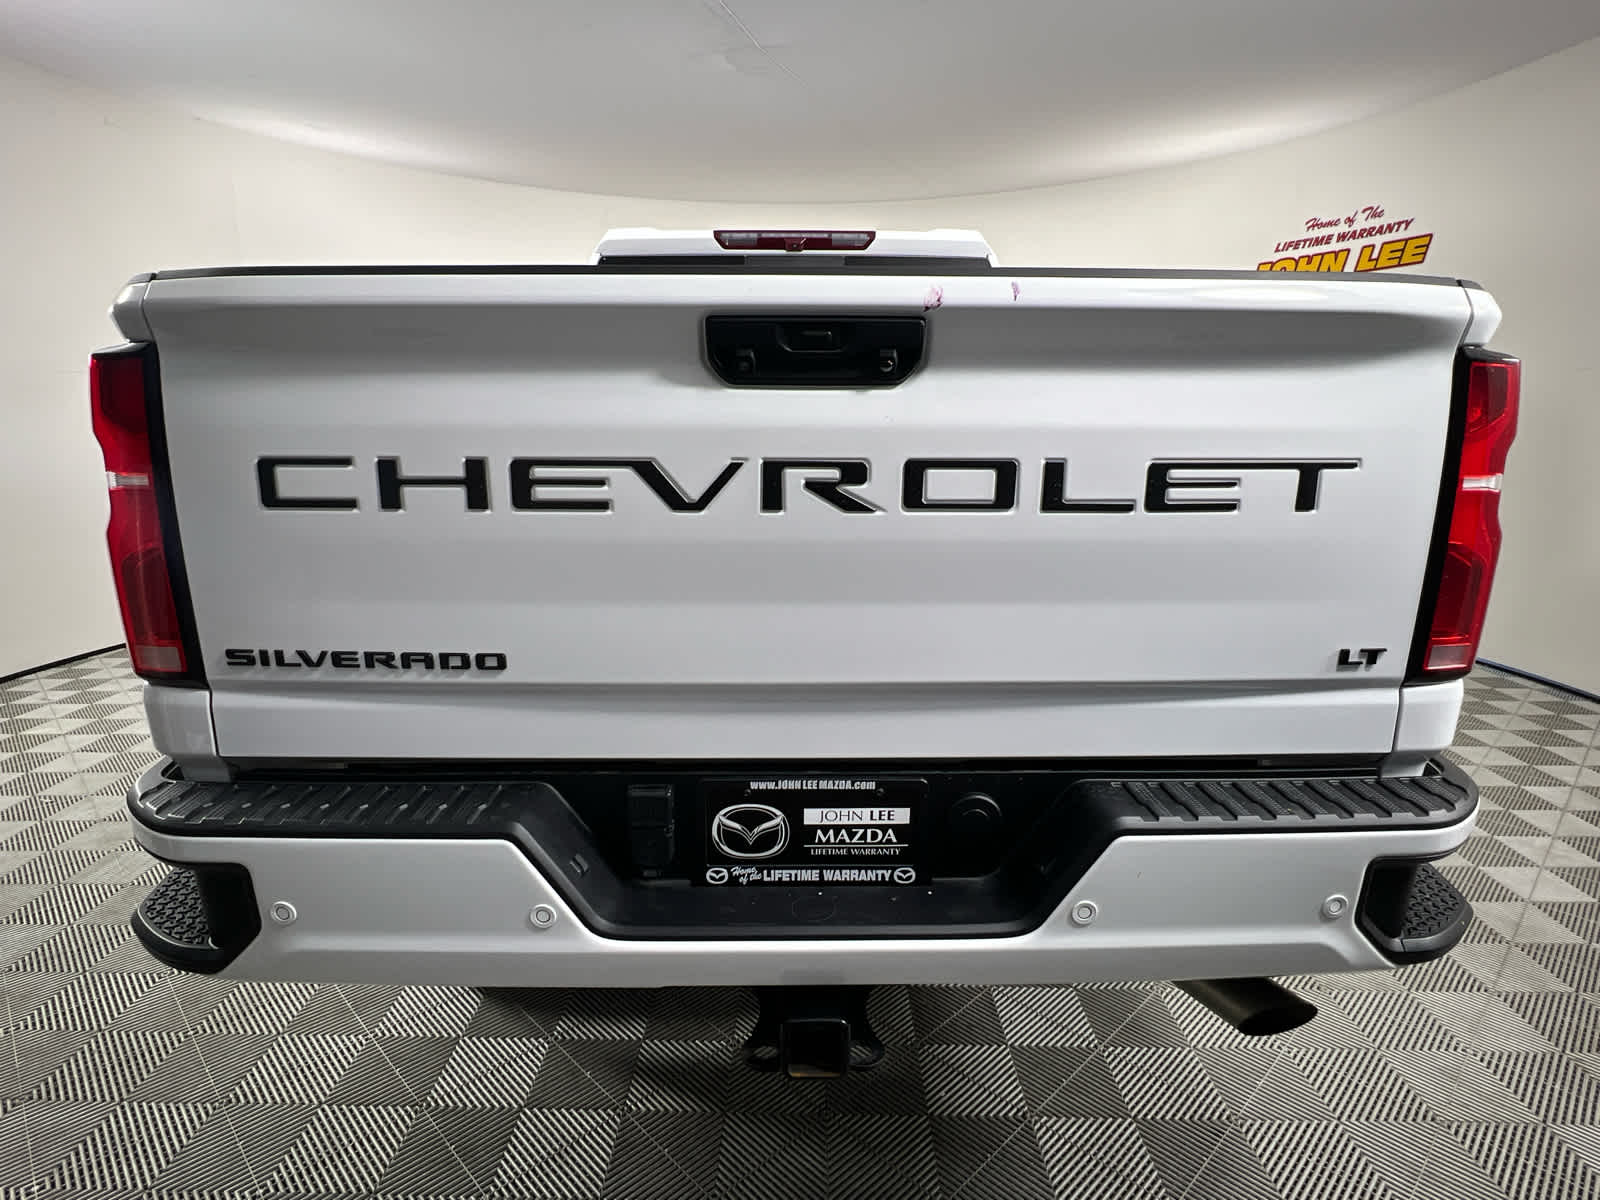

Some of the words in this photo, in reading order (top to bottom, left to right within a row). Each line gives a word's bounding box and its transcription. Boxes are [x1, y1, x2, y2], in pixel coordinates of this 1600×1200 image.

[1304, 217, 1341, 232] Home
[1343, 209, 1358, 227] of
[1362, 204, 1385, 221] The
[1274, 233, 1335, 253] LIFETIME
[1336, 218, 1415, 243] WARRANTY
[1354, 233, 1433, 273] LEE
[256, 456, 1361, 514] CHEVROLET
[225, 649, 508, 671] SILVERADO
[1336, 648, 1388, 669] LT
[820, 809, 863, 823] JOHN
[869, 810, 896, 822] LEE
[815, 828, 898, 844] MAZDA
[810, 848, 849, 856] LIFETIME
[850, 848, 901, 856] WARRANTY
[763, 869, 820, 882] LIFETIME
[823, 869, 892, 882] WARRANTY
